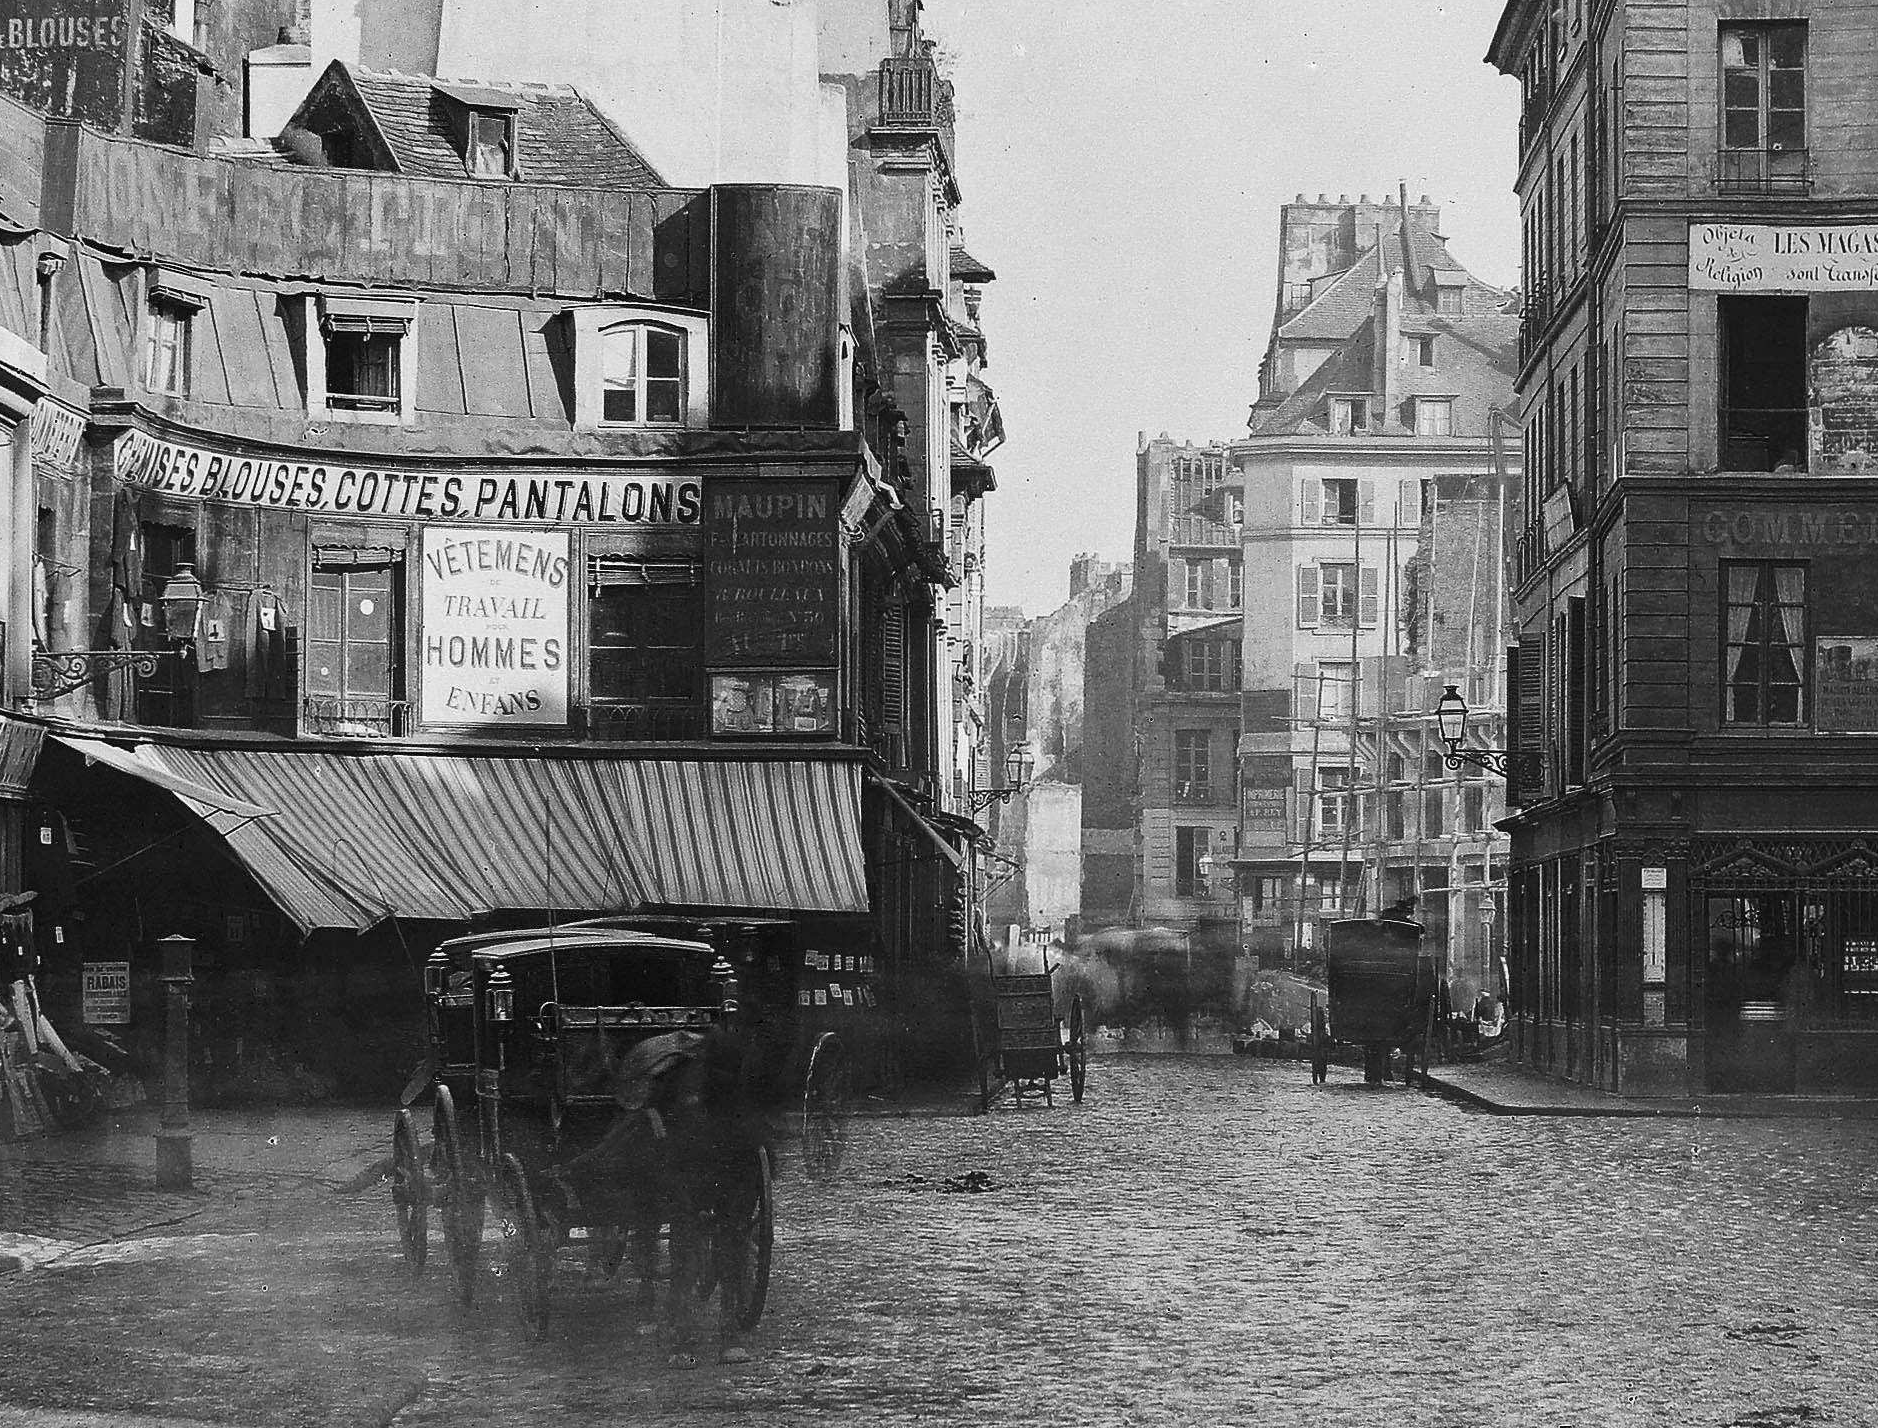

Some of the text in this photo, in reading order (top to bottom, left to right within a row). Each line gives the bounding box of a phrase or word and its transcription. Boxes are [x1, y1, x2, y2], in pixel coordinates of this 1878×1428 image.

[8, 16, 123, 49] BLOUSES
[1774, 231, 1811, 255] LES
[1695, 257, 1763, 290] Religion
[1786, 264, 1820, 282] sont
[474, 476, 700, 523] PANTALONS
[713, 494, 827, 520] MAUPIN
[427, 538, 569, 588] VÊTEMENS
[444, 595, 546, 620] TRAVAIL
[426, 635, 561, 671] HOMMES
[445, 686, 542, 716] ENFANS
[86, 975, 126, 990] RABAIS
